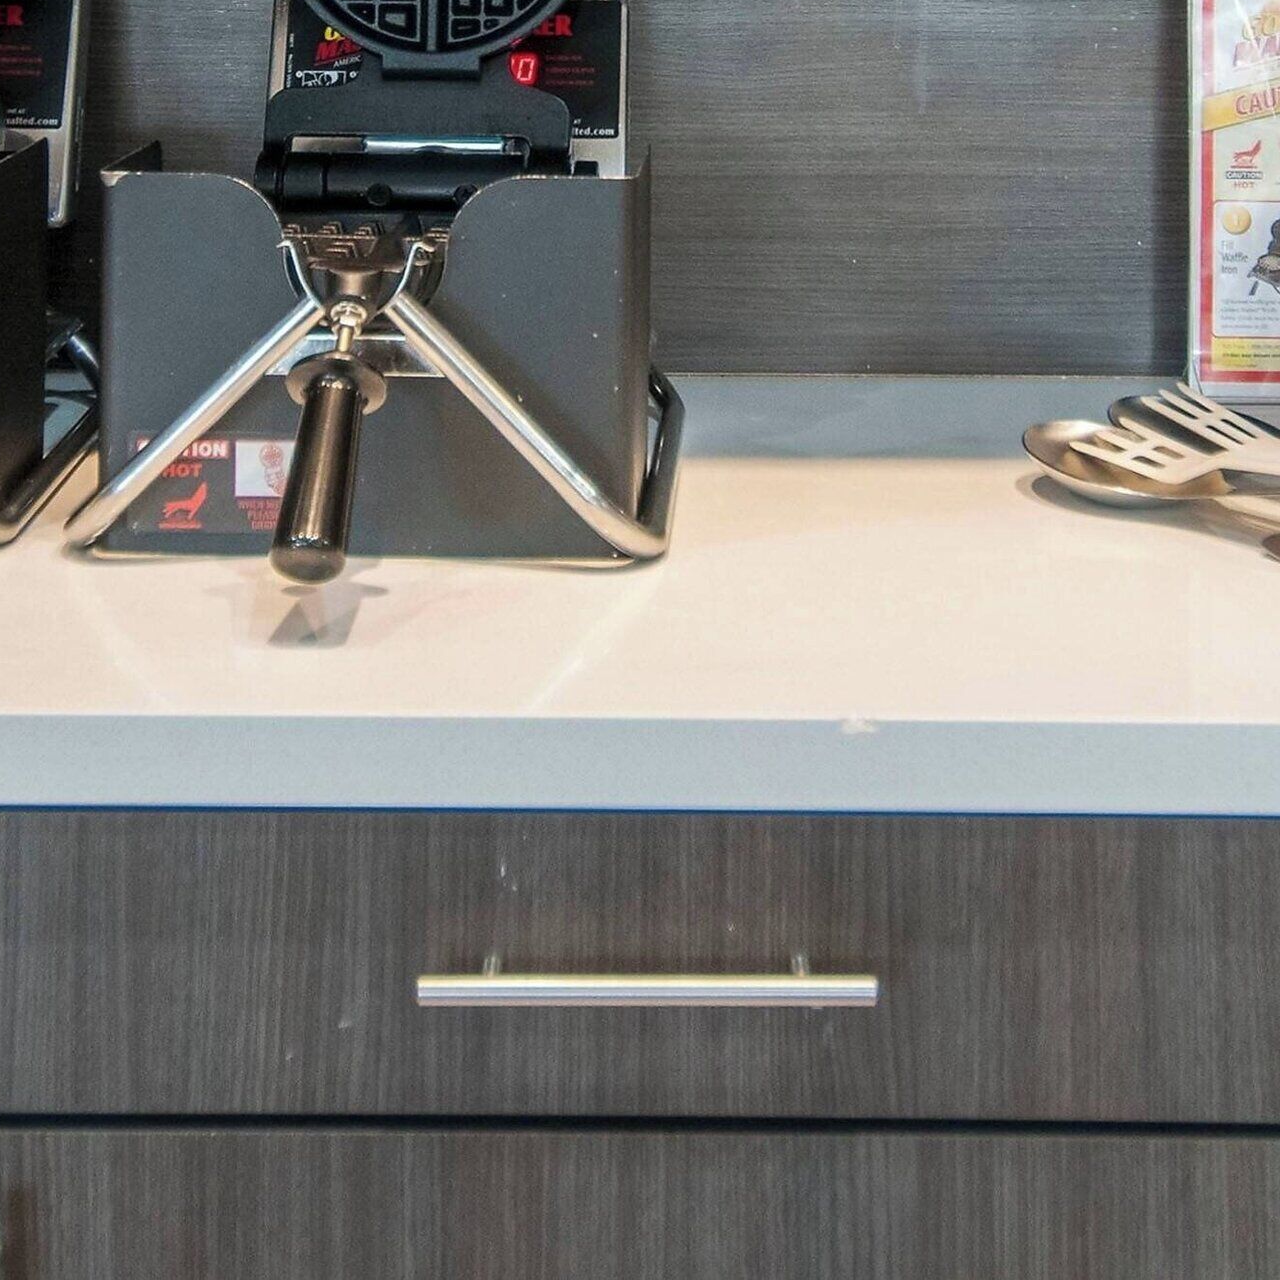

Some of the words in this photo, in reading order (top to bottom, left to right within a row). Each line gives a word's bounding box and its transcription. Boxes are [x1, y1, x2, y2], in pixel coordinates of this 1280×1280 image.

[6, 116, 59, 126] alted.com
[1226, 171, 1263, 179] CAUTION
[1233, 181, 1255, 190] HOT
[1222, 252, 1249, 263] Waffle
[1221, 265, 1238, 275] Iron
[162, 463, 202, 477] HOT
